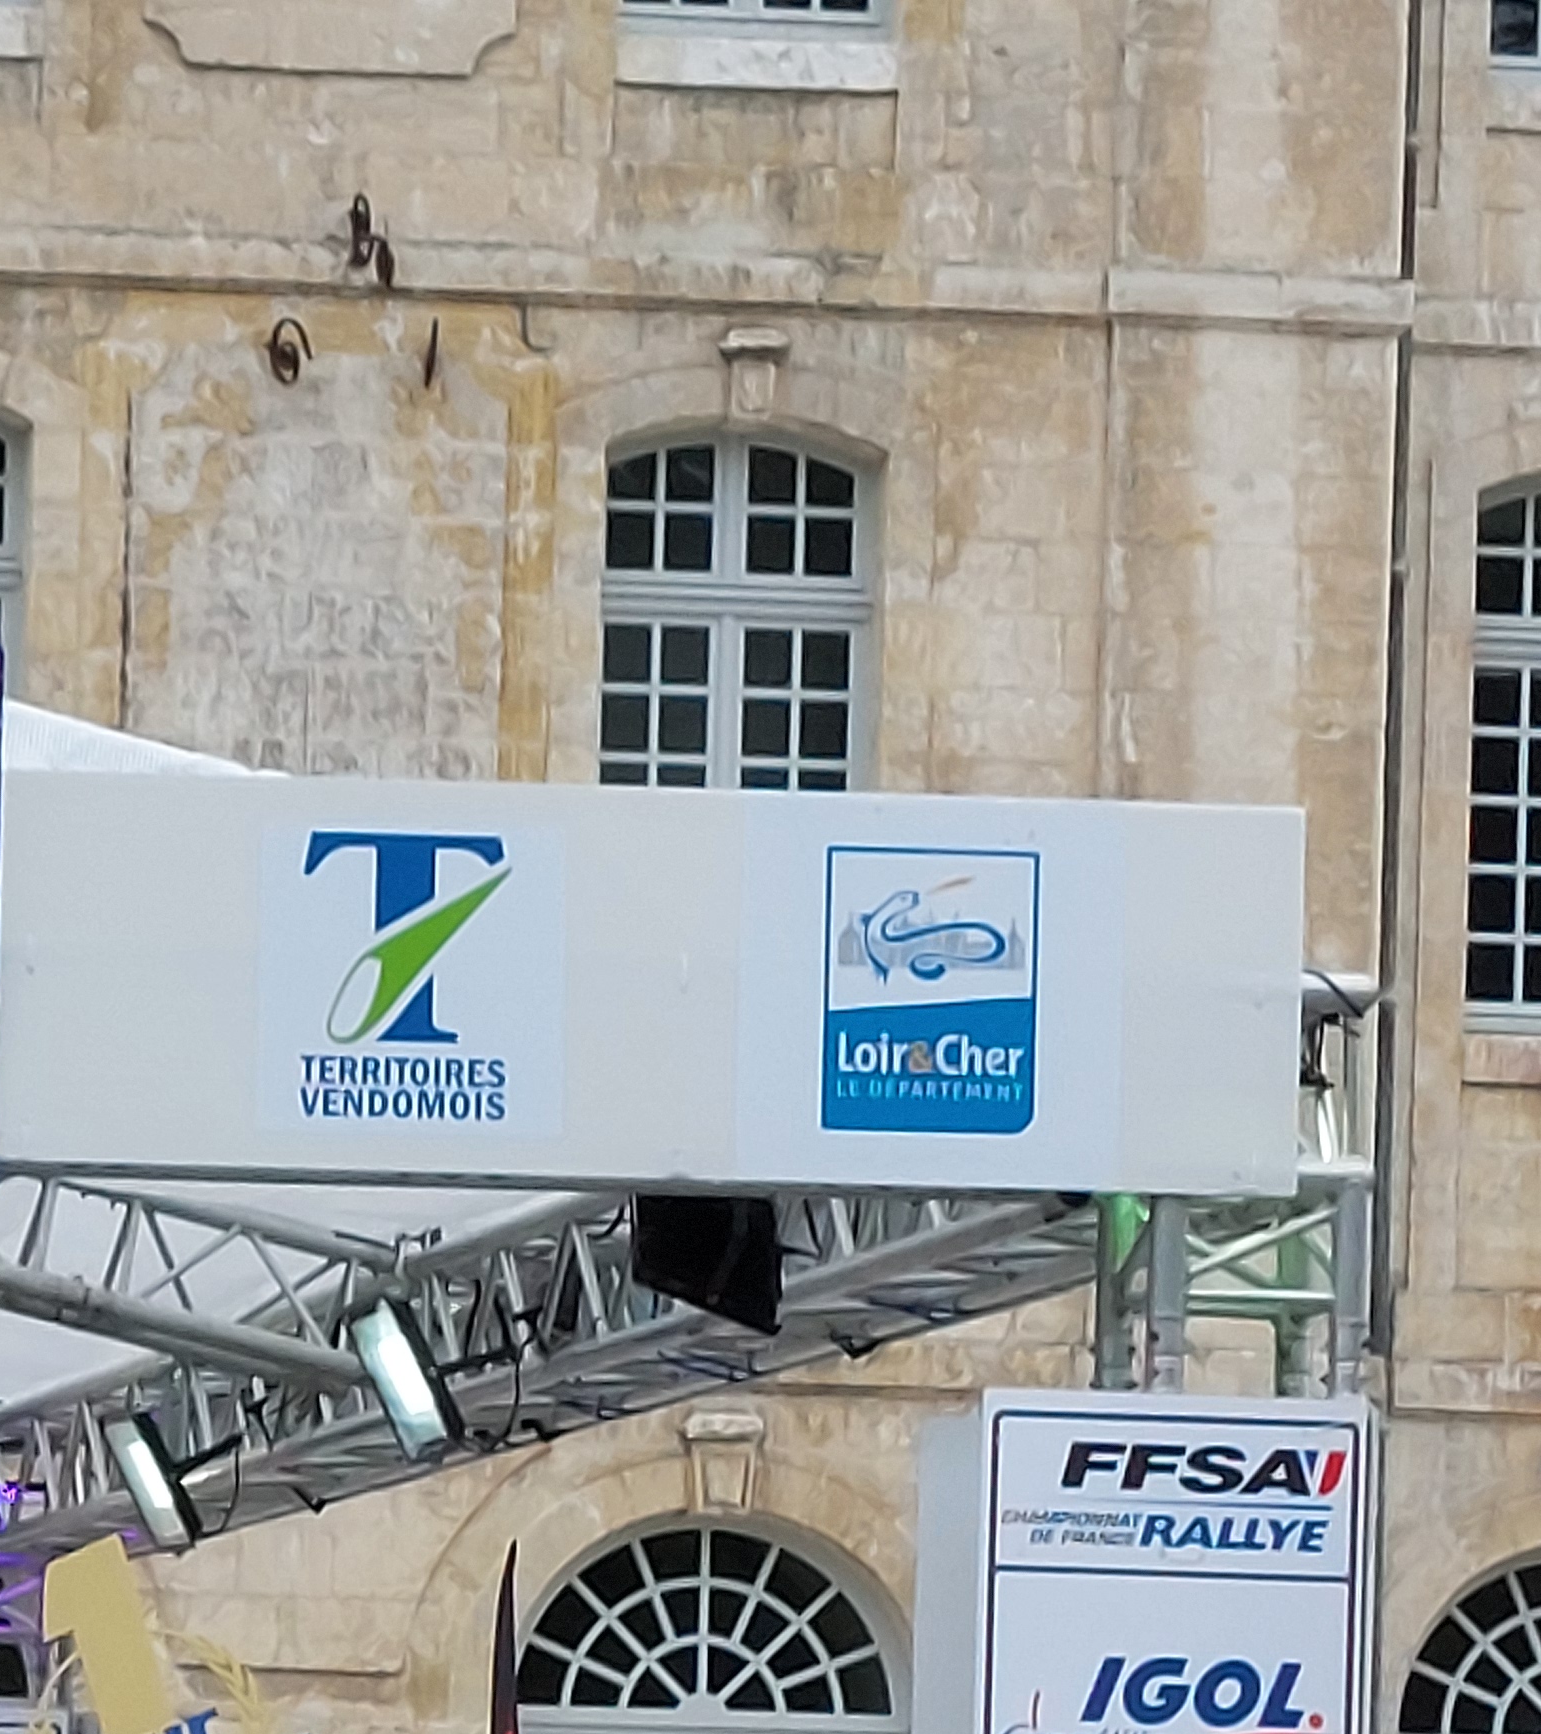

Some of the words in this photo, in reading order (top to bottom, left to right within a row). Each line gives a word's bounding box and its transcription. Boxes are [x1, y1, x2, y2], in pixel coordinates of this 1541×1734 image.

[299, 1054, 507, 1089] TERRITOIRES
[298, 1087, 507, 1122] VENDOMOIS
[1059, 1441, 1313, 1497] FFSA
[1029, 1530, 1054, 1545] DE
[1060, 1531, 1136, 1547] FRANCE
[1139, 1513, 1331, 1553] RALLYE
